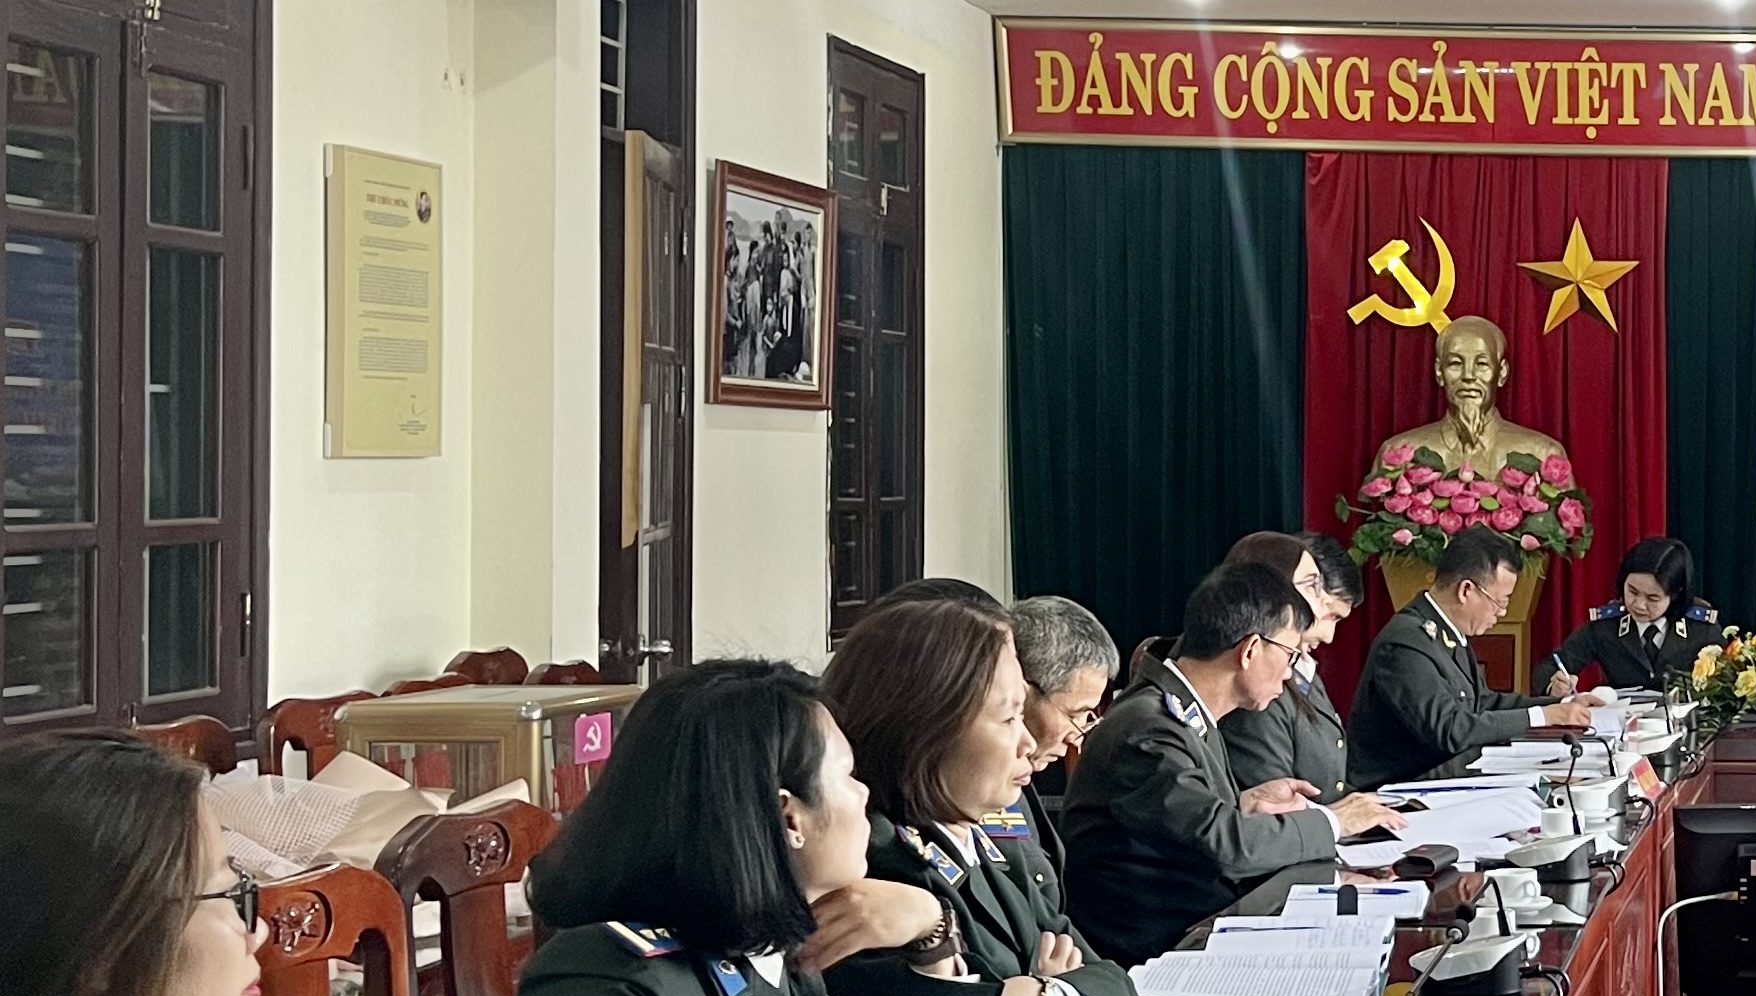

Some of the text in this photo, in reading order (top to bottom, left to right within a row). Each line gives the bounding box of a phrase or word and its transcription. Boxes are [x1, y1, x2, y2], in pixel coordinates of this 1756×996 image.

[1035, 33, 1199, 118] ĐẢNG
[1214, 41, 1375, 134] CỘNG
[1387, 41, 1498, 124] SẢN
[1511, 47, 1647, 139] VIỆT
